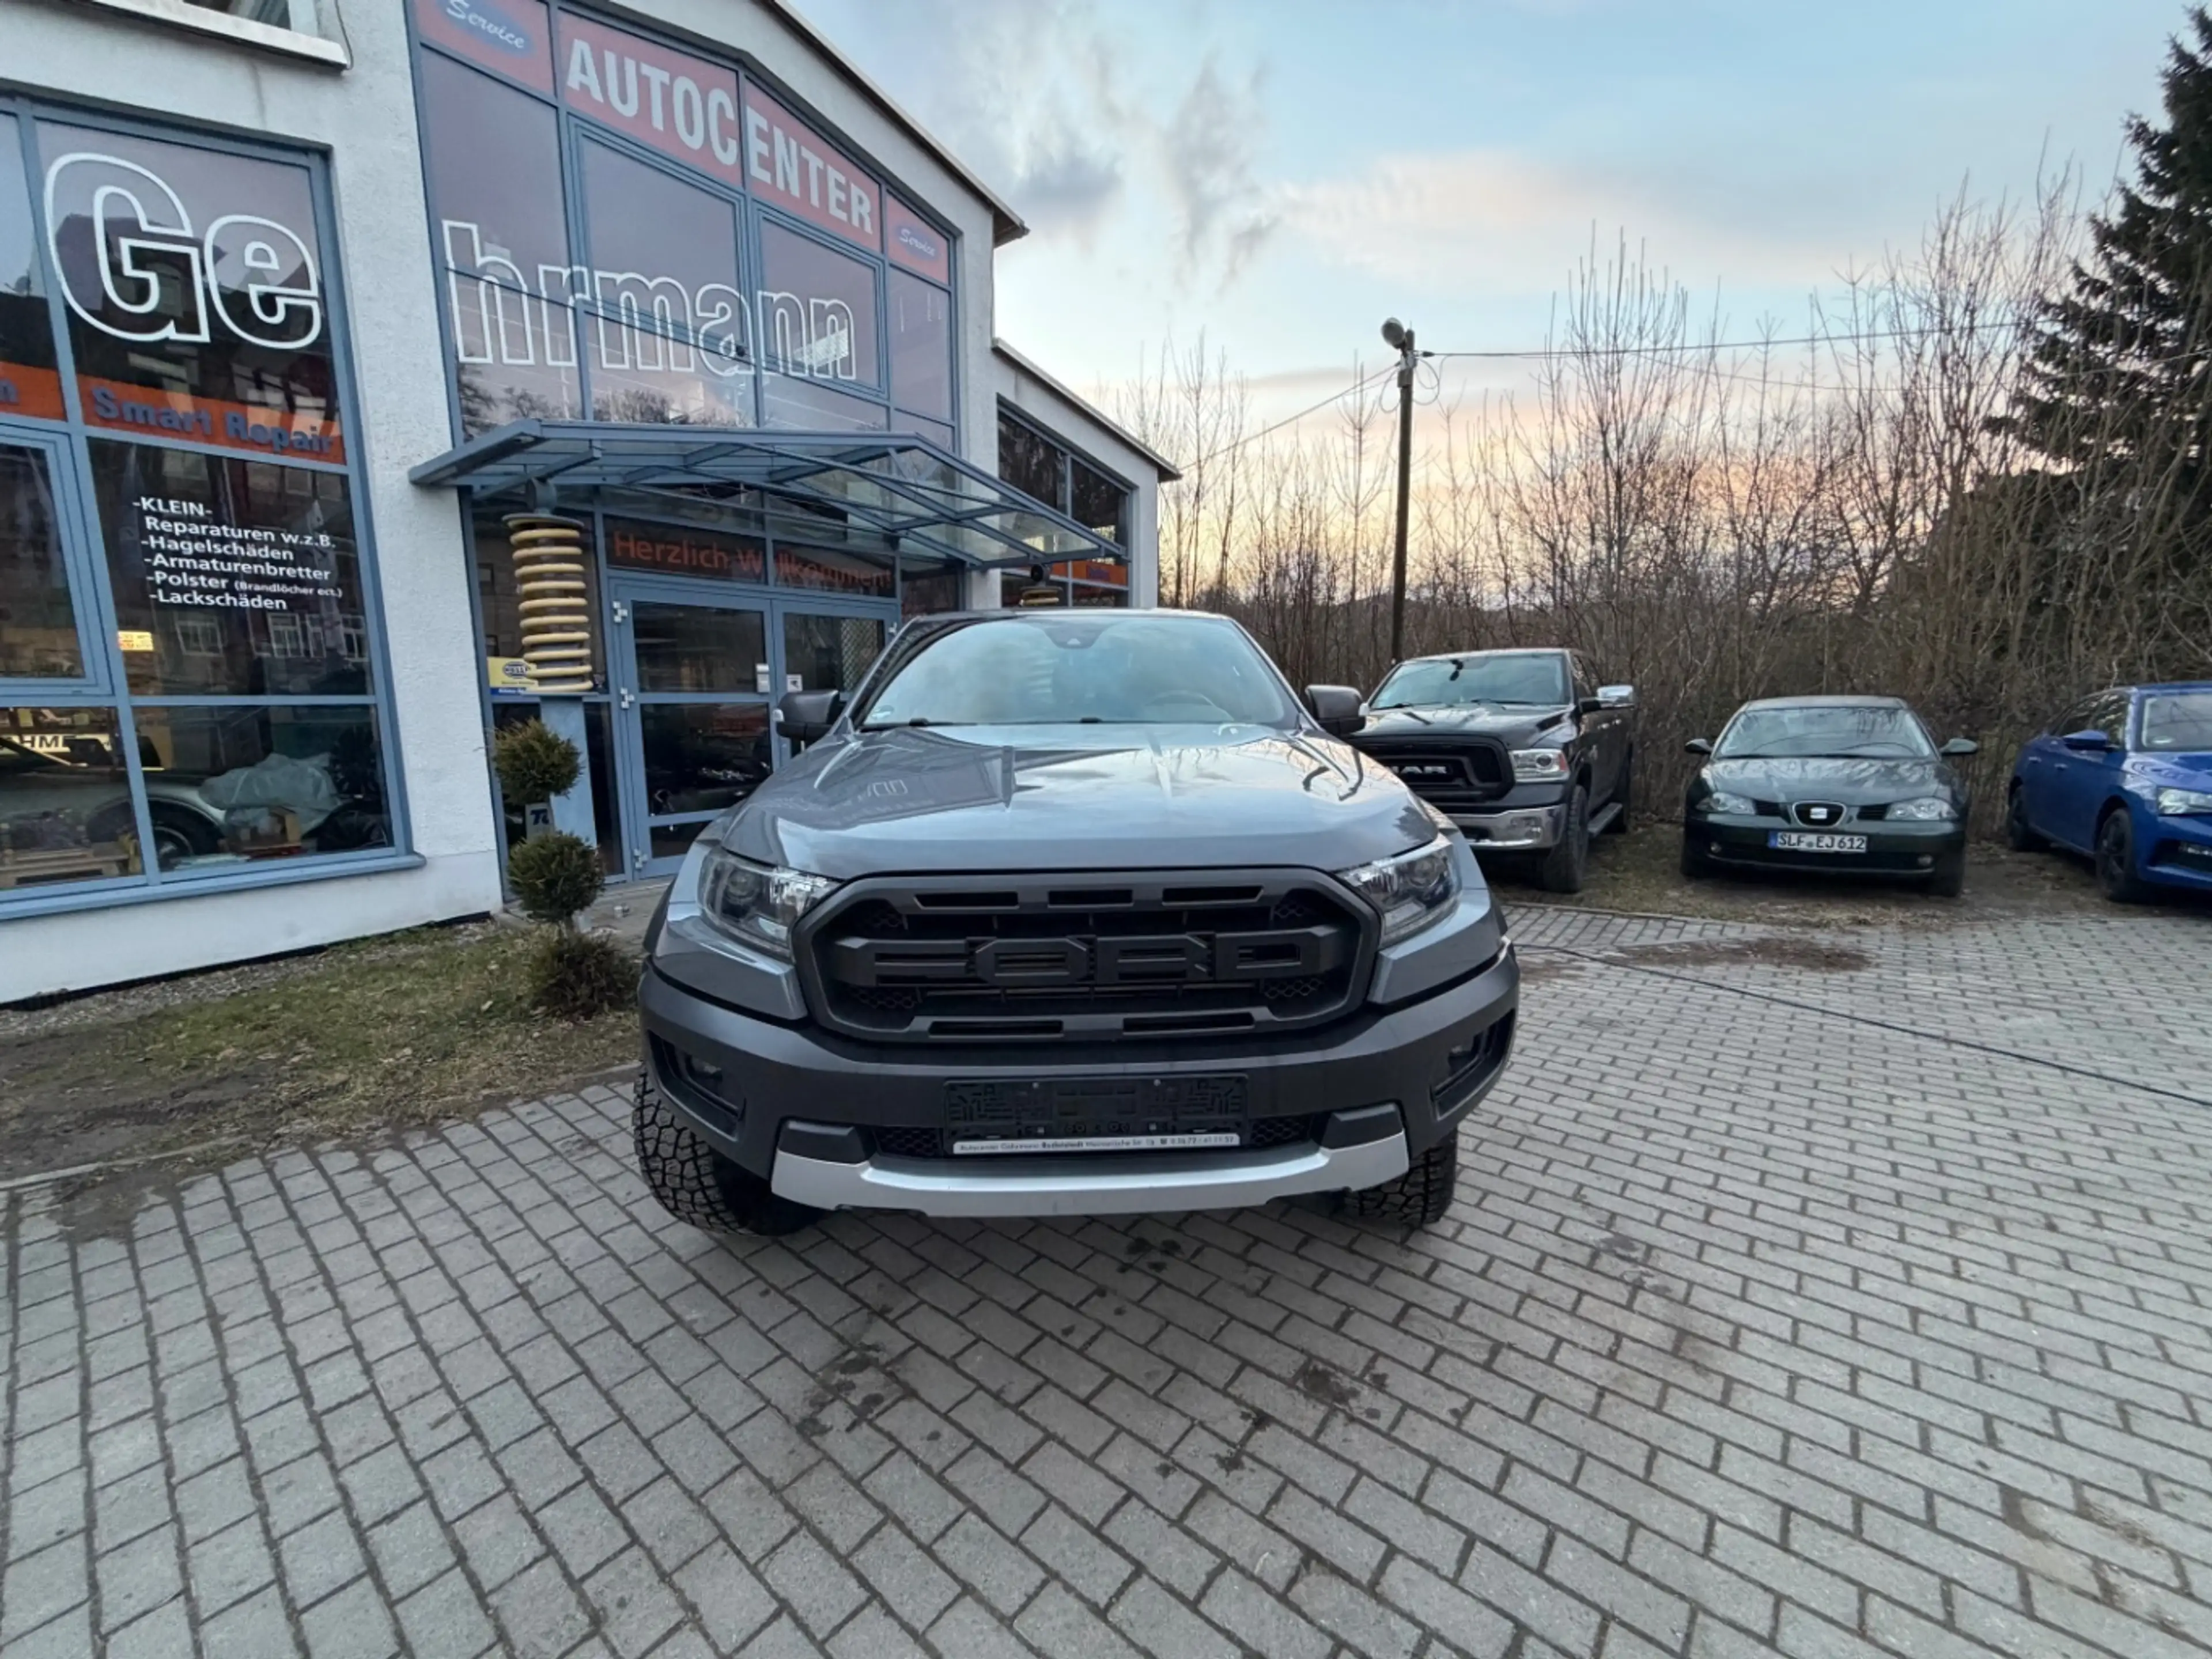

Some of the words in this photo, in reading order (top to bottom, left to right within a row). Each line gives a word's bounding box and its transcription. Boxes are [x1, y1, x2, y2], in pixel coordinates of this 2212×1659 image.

[446, 0, 524, 48] Service
[566, 38, 873, 235] AUTOCENTER
[44, 152, 322, 349] Ge
[91, 385, 213, 435] Smart
[224, 410, 335, 454] Repair
[145, 516, 281, 542] Reparaturen
[613, 530, 729, 570] Herzlich
[1778, 834, 1806, 847] SLF
[835, 926, 1338, 987] FORD
